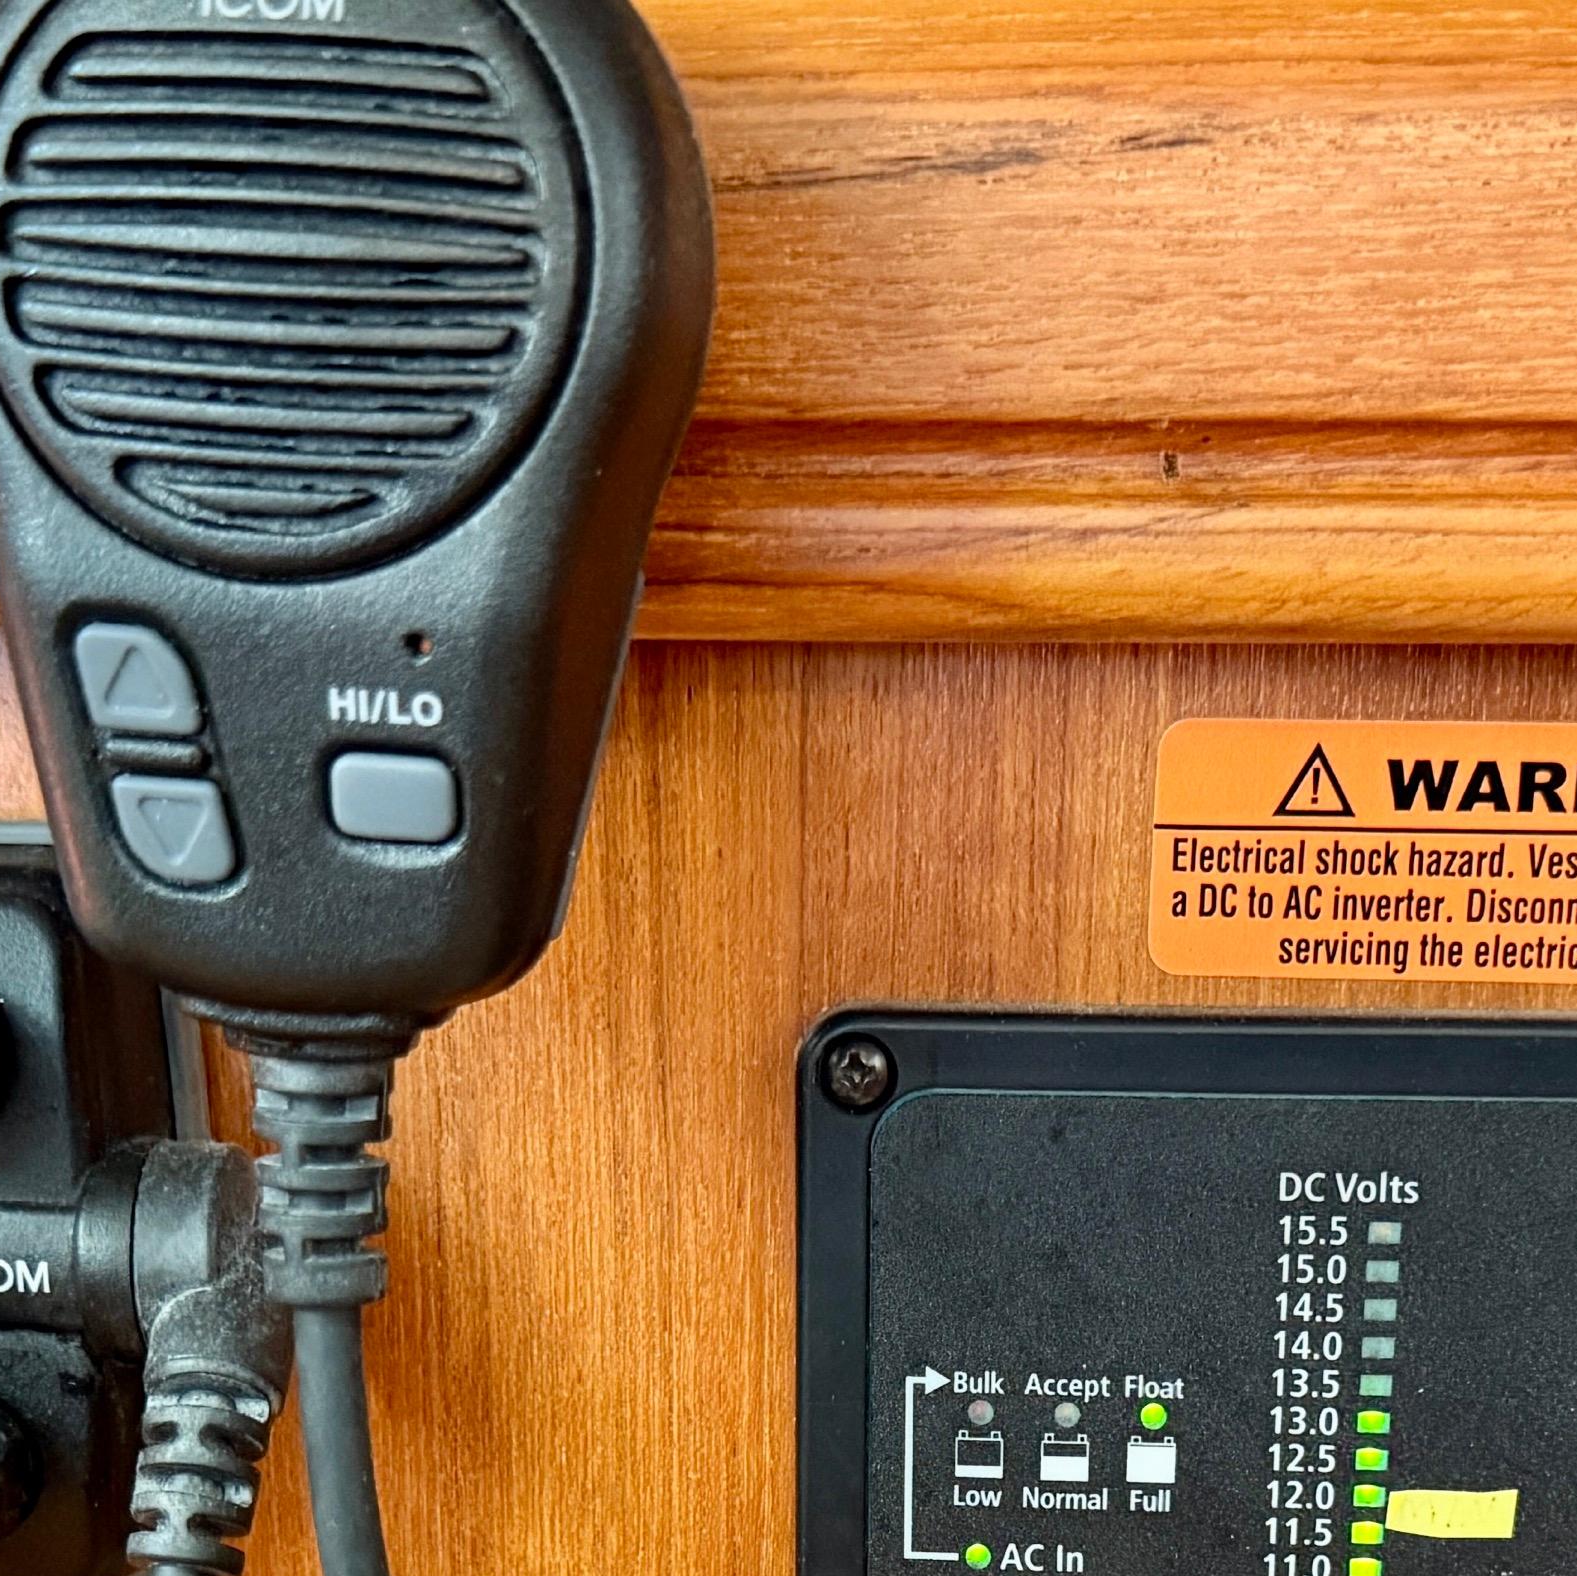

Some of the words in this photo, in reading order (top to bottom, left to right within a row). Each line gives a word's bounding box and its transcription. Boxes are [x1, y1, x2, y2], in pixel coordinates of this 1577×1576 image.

[329, 688, 442, 728] HI/LO
[1172, 838, 1307, 874] Electrical
[1316, 840, 1399, 877] shock
[1408, 842, 1514, 879] hazard.
[1172, 893, 1187, 917] a
[1199, 886, 1237, 917] DC
[1247, 891, 1273, 919] to
[1282, 888, 1321, 920] AC
[1333, 890, 1452, 924] inverter.
[1278, 934, 1408, 972] servicing
[1420, 933, 1465, 968] the
[1279, 1172, 1326, 1202] DC
[1336, 1172, 1420, 1204] Volts
[1280, 1216, 1349, 1246] 15.5
[1277, 1254, 1347, 1284] 15.0
[1275, 1293, 1344, 1322] 14.5
[1273, 1331, 1343, 1361] 14.0
[953, 1371, 1005, 1395] Bulk
[1024, 1373, 1111, 1403] Accept
[1124, 1375, 1185, 1400] Float
[1271, 1369, 1340, 1399] 13.5
[1270, 1406, 1339, 1436] 13.0
[1268, 1444, 1336, 1473] 12.5
[953, 1485, 1002, 1507] Low
[1022, 1487, 1108, 1511] Normal
[1129, 1490, 1171, 1512] Full
[1266, 1481, 1335, 1510] 12.0
[1265, 1518, 1333, 1547] 11.5
[1000, 1543, 1045, 1572] AC
[1056, 1544, 1084, 1573] In
